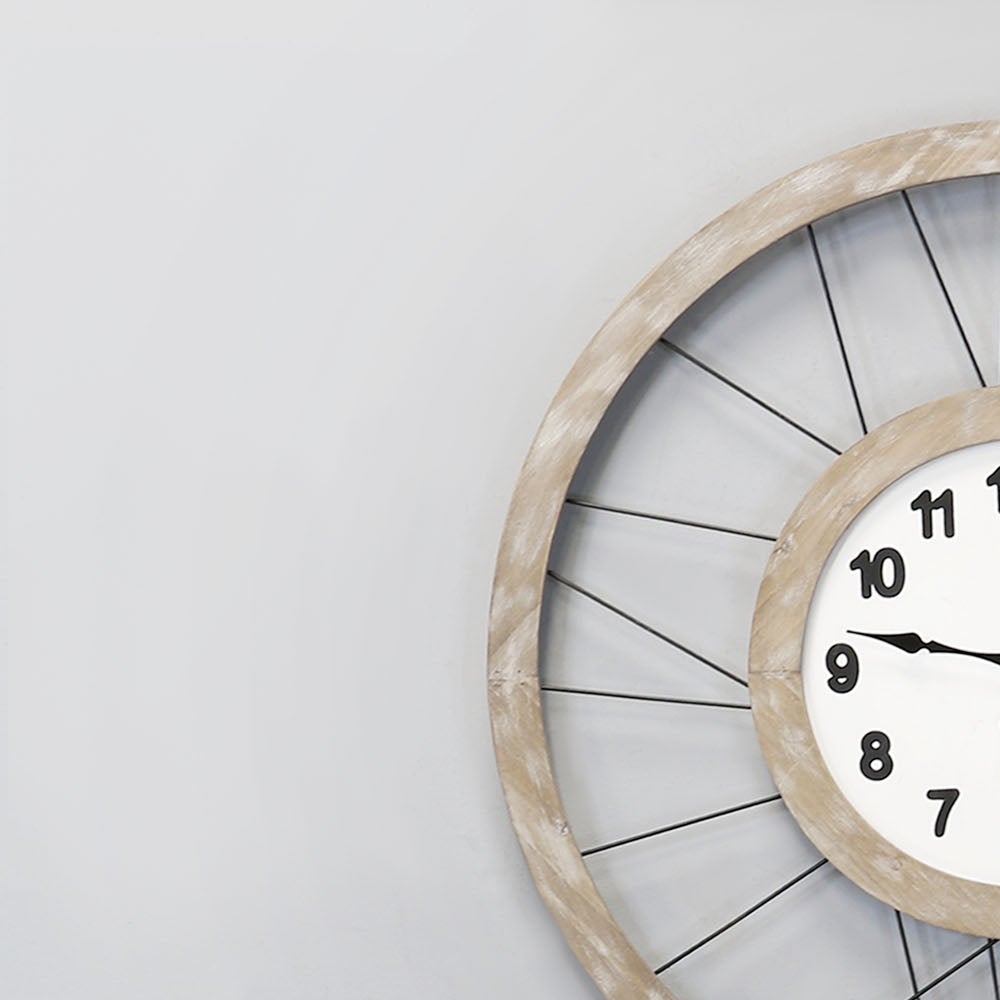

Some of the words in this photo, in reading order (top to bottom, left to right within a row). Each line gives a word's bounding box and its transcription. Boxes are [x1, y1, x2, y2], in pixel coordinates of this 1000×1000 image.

[911, 489, 954, 539] 11
[850, 548, 906, 599] 10
[826, 643, 859, 693] 9
[860, 731, 893, 781] 8
[927, 789, 959, 837] 7
